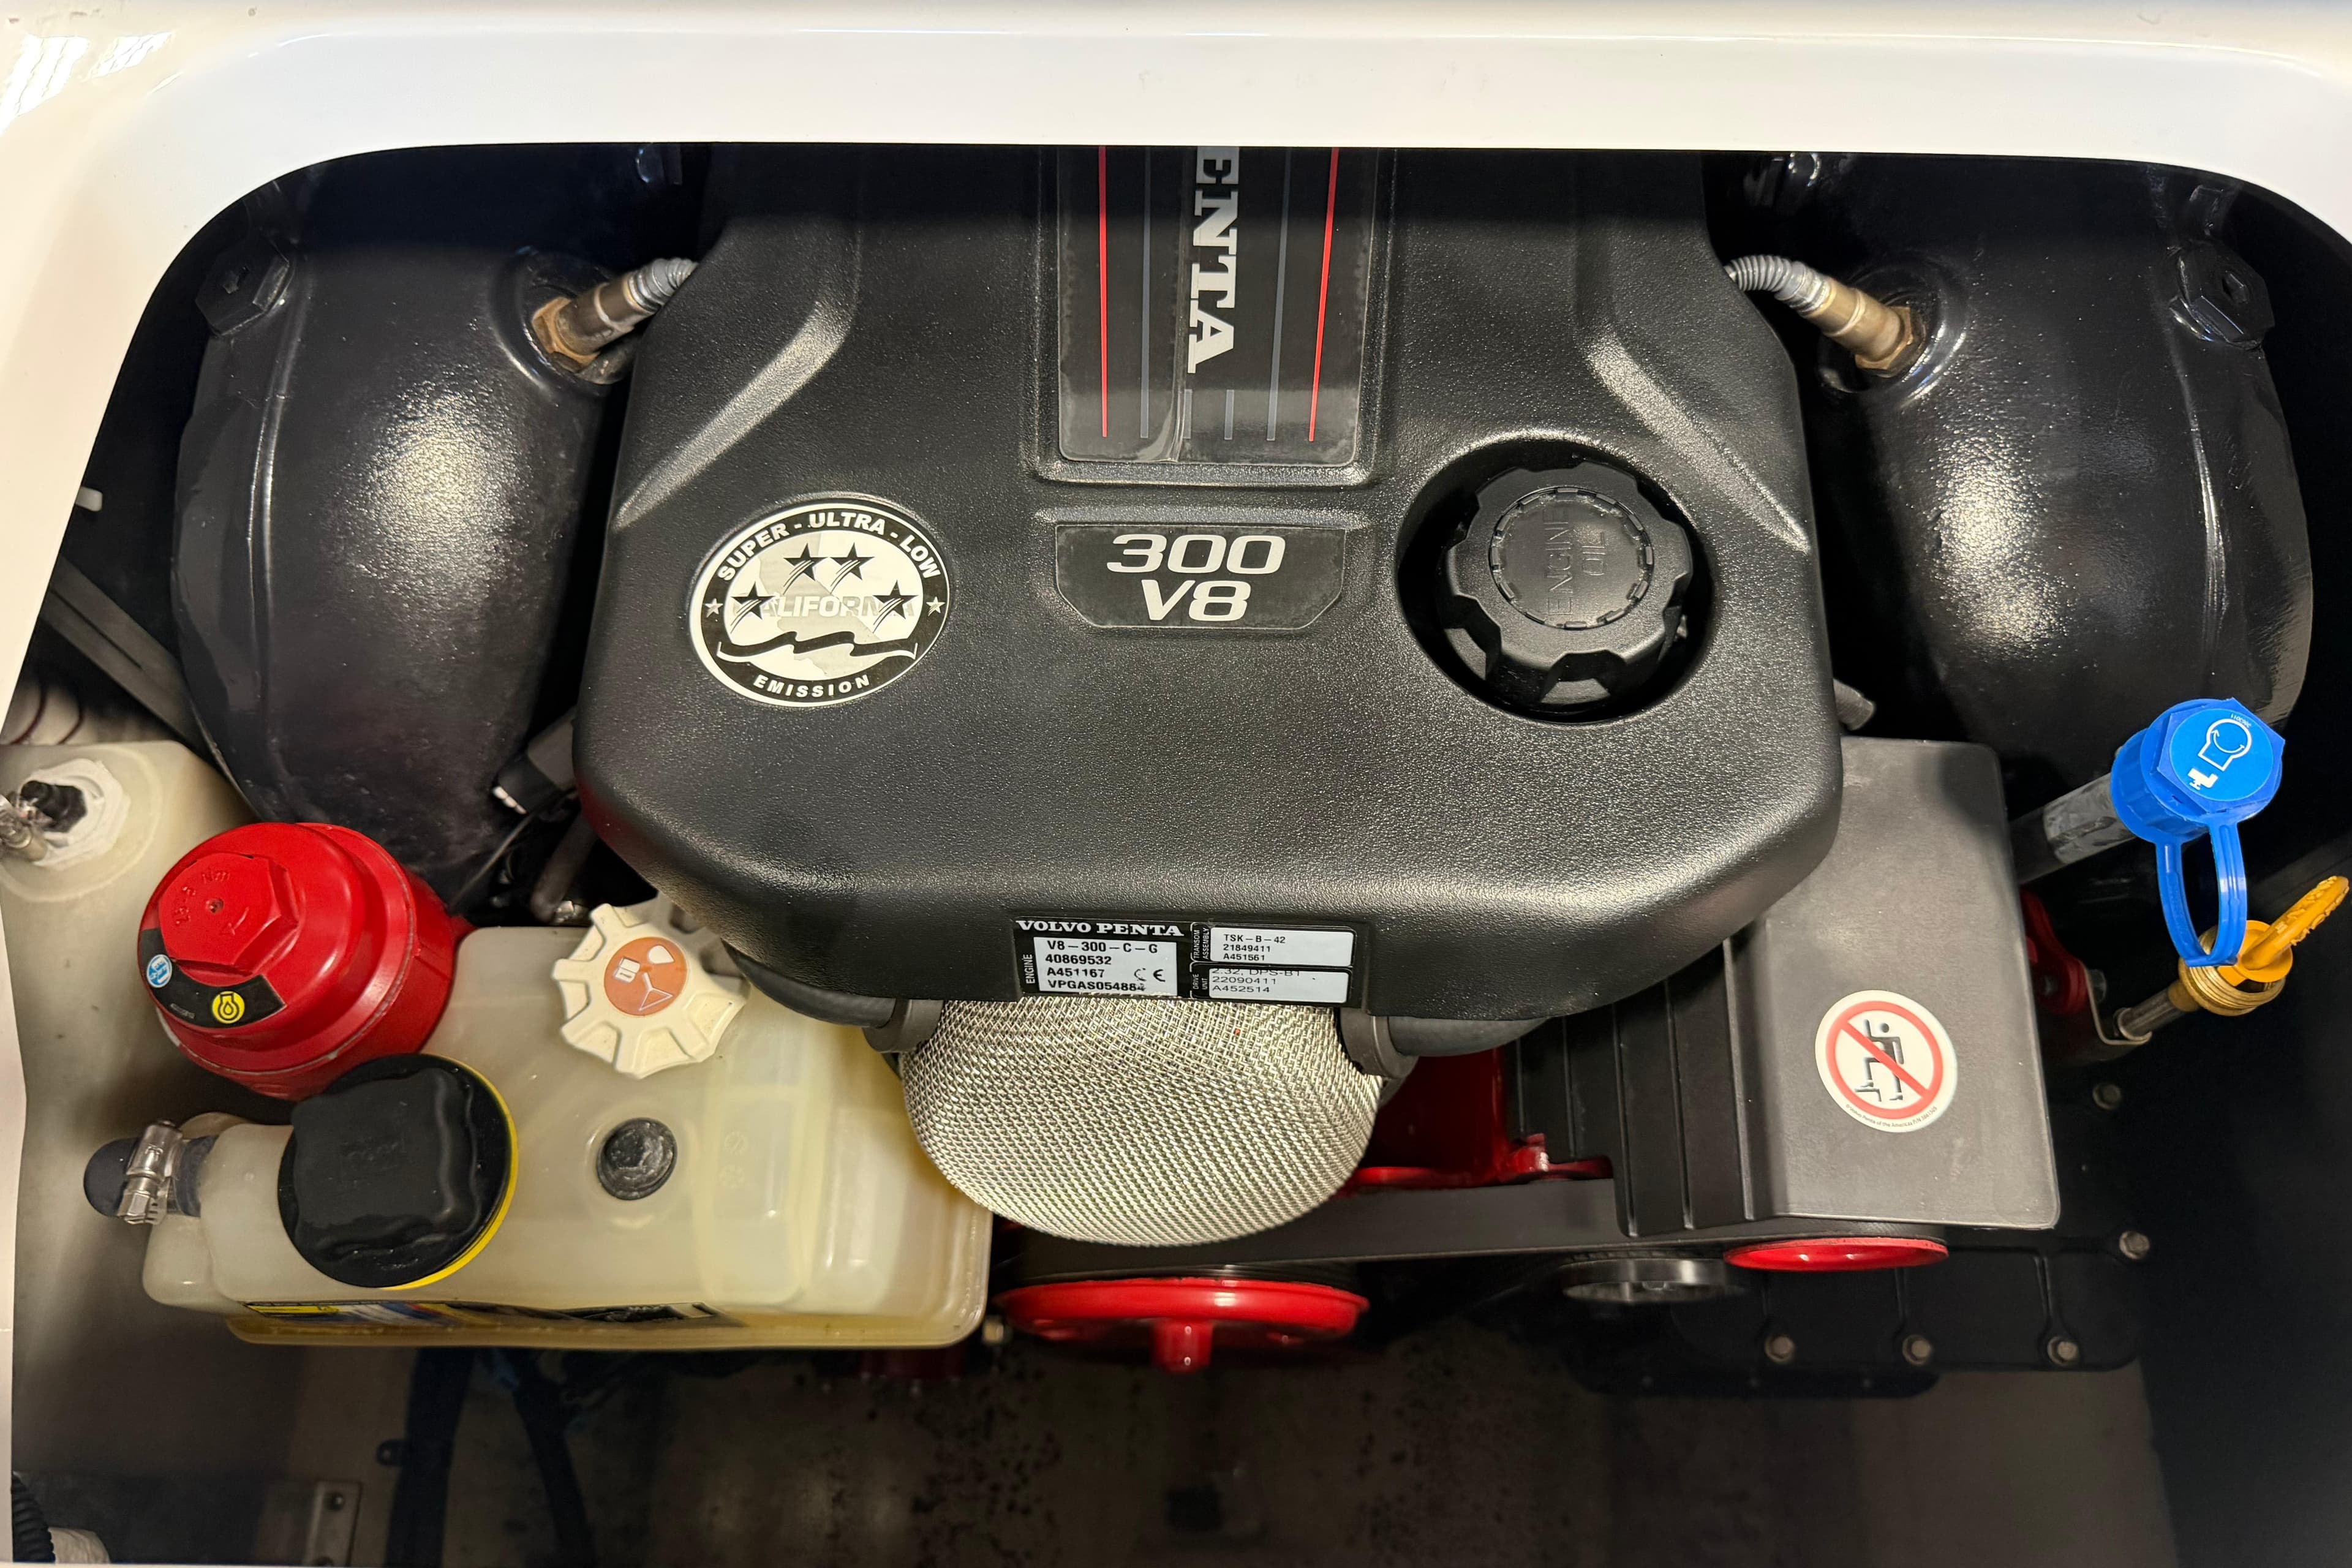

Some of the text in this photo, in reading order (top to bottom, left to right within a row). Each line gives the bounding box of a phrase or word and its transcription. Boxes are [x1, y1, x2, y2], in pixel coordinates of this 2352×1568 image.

[717, 522, 790, 581] SUPER
[809, 512, 886, 535] ULTRA
[899, 535, 941, 579] LOW
[1107, 533, 1286, 575] 300
[1581, 531, 1608, 576] OIL
[1542, 508, 1573, 616] ENGINE
[1141, 579, 1251, 621] V8
[753, 674, 870, 698] EMISSION
[1016, 921, 1185, 936] VOLVO PENTA
[1045, 954, 1112, 965] 40869532
[1223, 944, 1270, 952] 21849411
[1022, 954, 1036, 984] ENGINE
[1047, 967, 1105, 978] A451167
